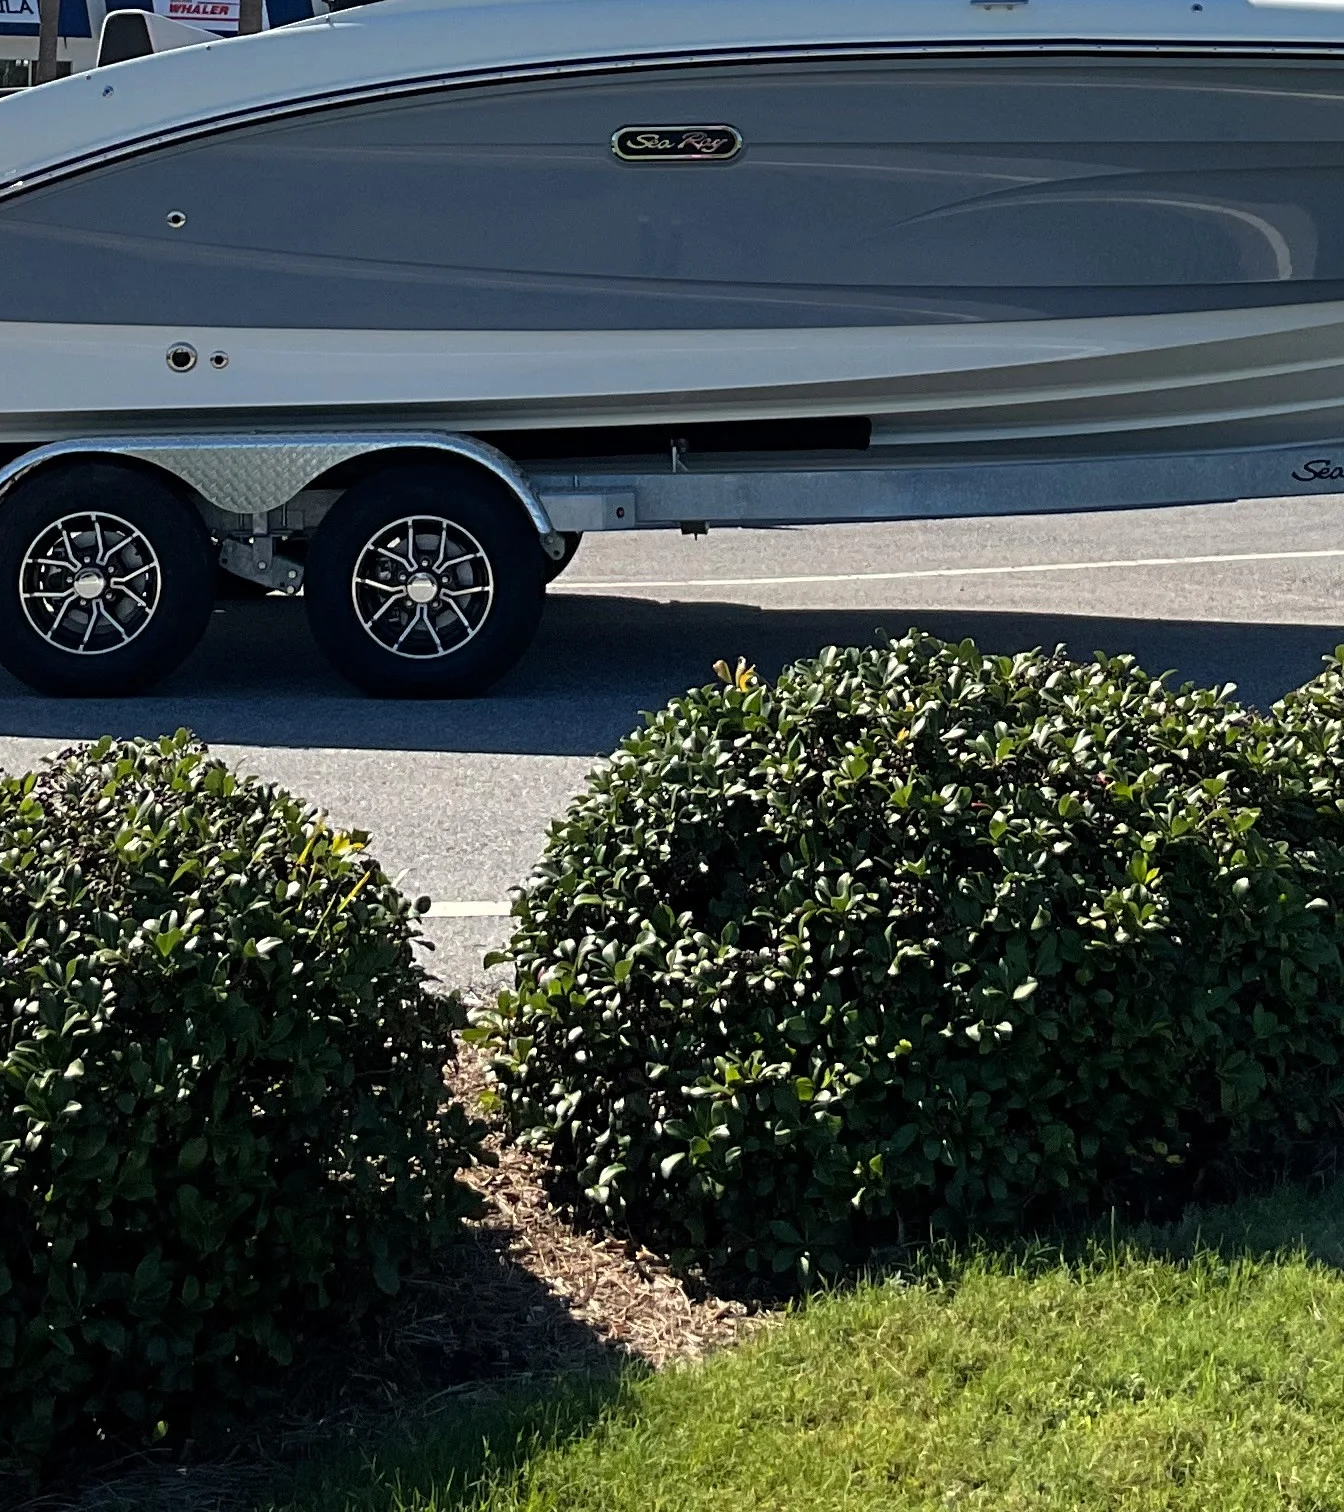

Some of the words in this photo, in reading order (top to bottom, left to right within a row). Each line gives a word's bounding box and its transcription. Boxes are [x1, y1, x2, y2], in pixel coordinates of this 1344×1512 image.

[169, 3, 230, 16] WHALER
[626, 133, 676, 150] Sea
[677, 131, 729, 153] Ray
